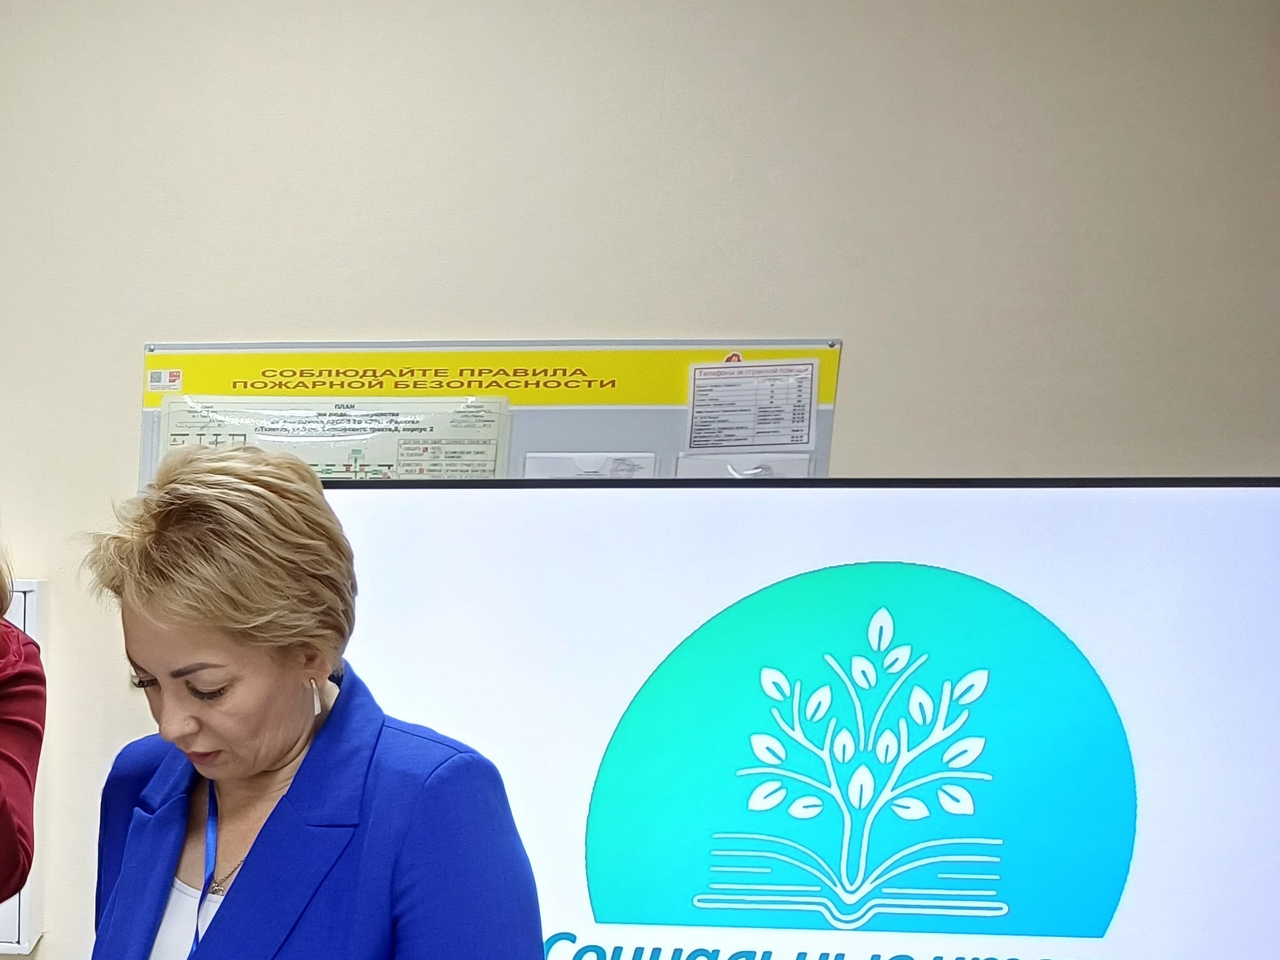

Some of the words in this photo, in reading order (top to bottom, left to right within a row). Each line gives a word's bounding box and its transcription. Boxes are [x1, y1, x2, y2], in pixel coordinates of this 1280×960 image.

[261, 366, 449, 378] СОБЛЮДАЙТЕ
[459, 367, 588, 378] ПРАВИЛА
[232, 378, 384, 390] ПОЖАРНОЙ
[393, 379, 617, 389] БЕЗОПАСНОСТИ
